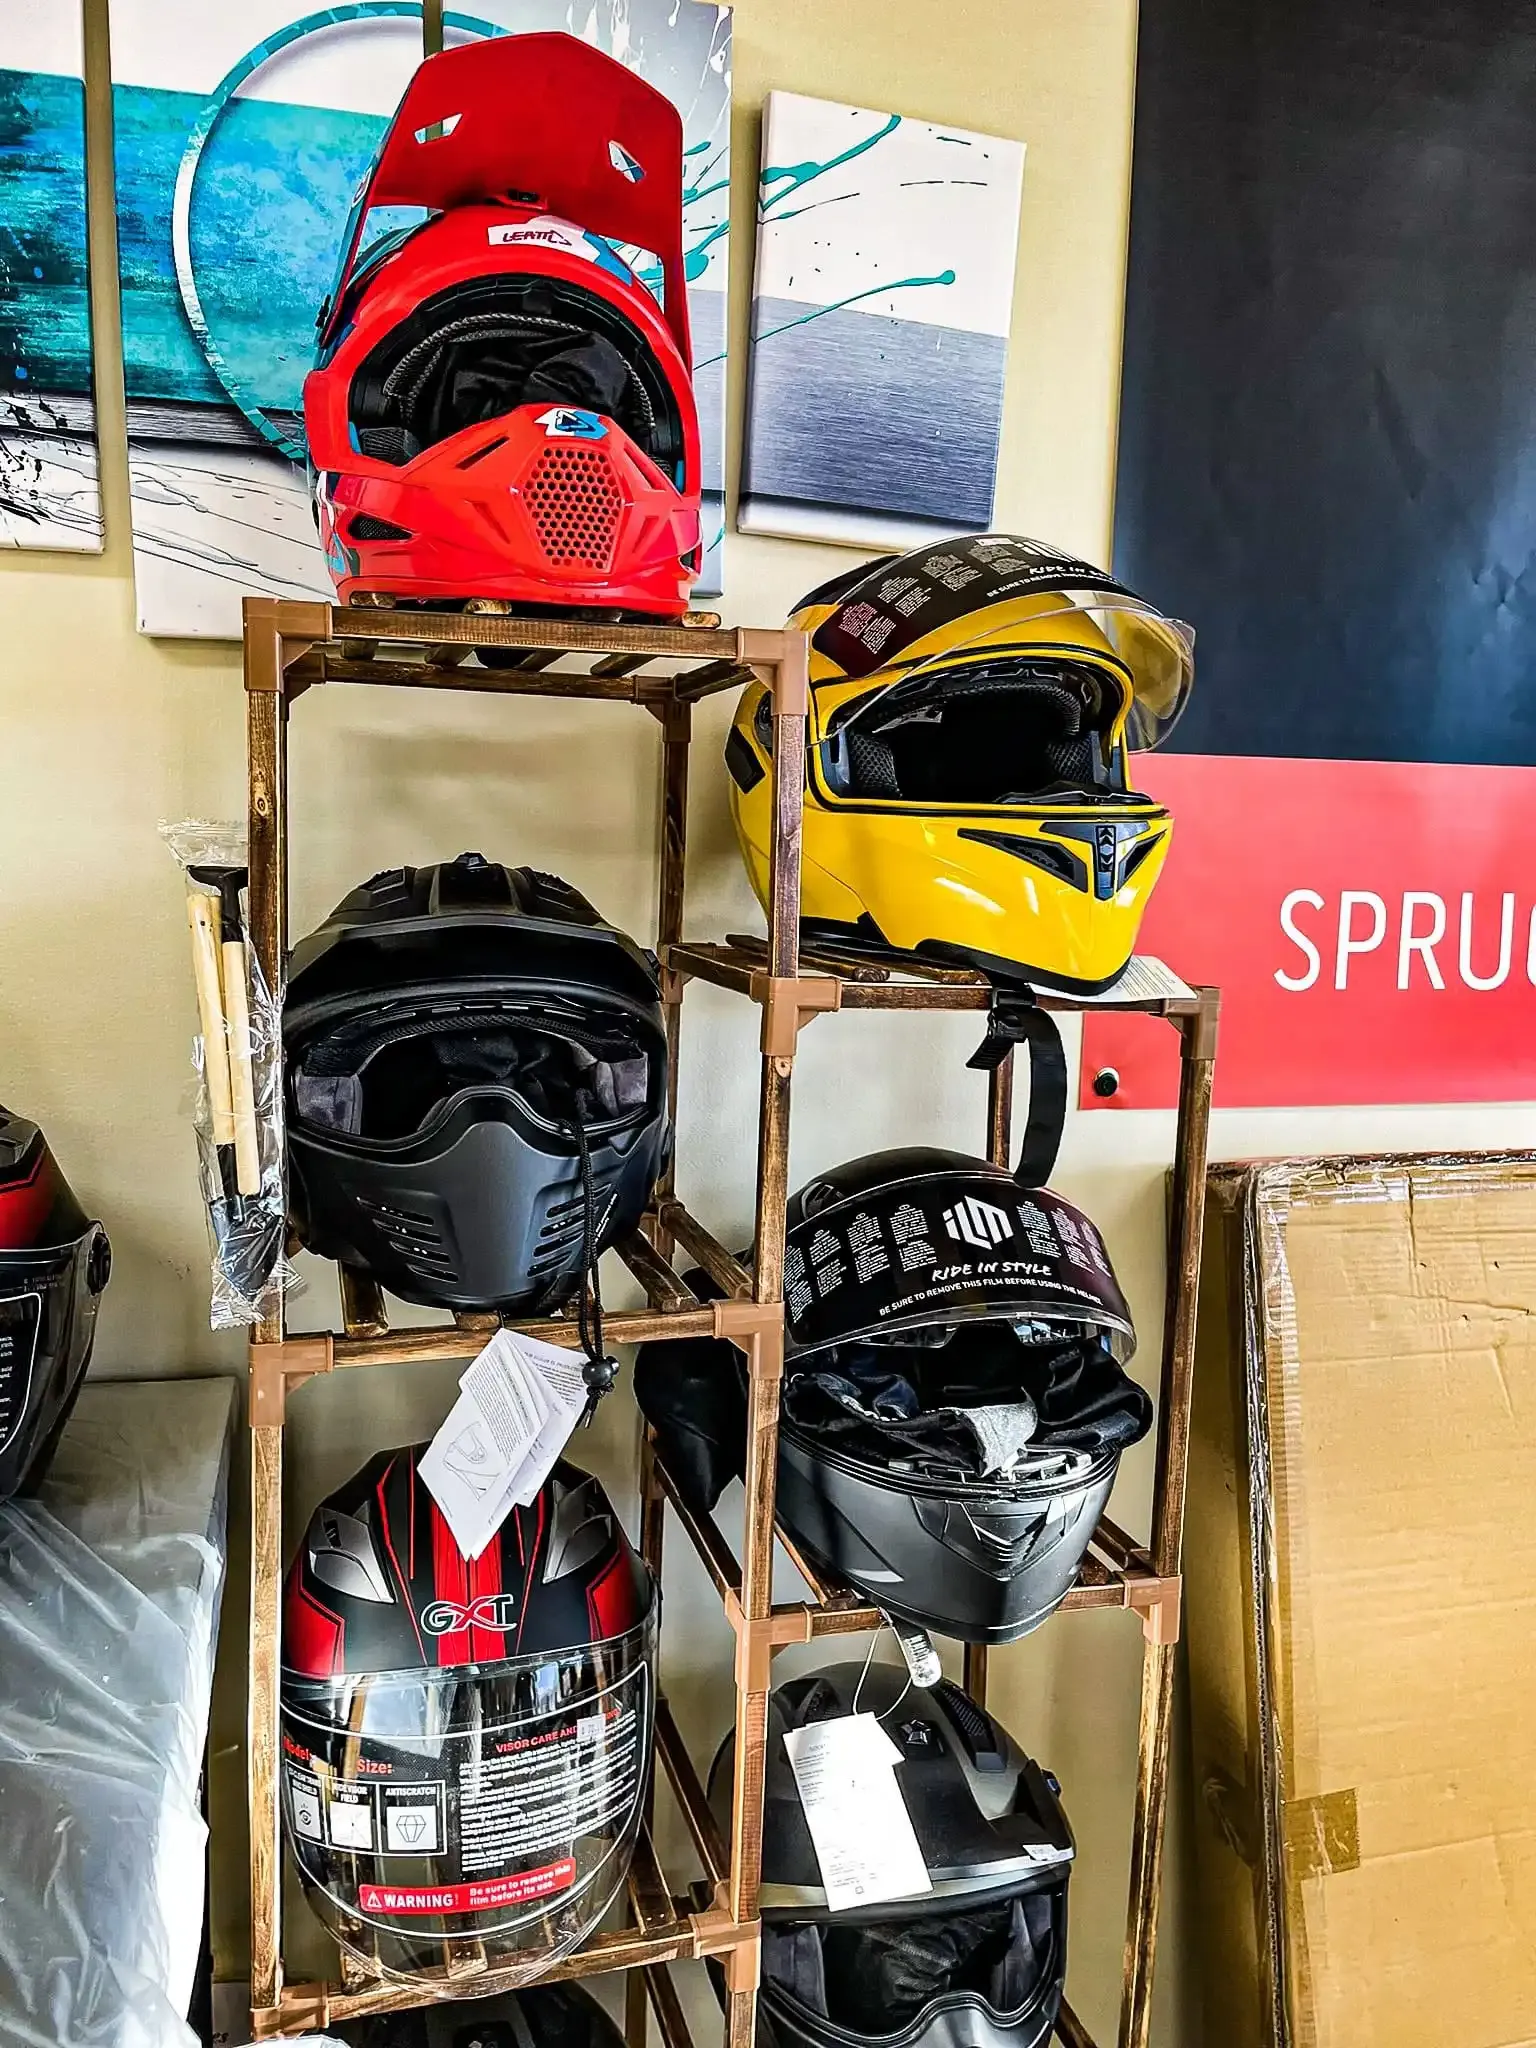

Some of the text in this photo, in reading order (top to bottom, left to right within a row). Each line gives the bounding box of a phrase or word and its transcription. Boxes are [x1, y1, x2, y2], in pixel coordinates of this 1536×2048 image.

[1273, 888, 1536, 992] SPRU
[931, 1262, 1052, 1281] RIDE IN STYLE
[879, 1305, 891, 1316] BE
[891, 1296, 914, 1311] SURE
[914, 1292, 926, 1300] TO
[926, 1282, 962, 1297] REMOVE
[962, 1280, 982, 1289] THIS
[982, 1278, 1004, 1286] FILM
[1004, 1278, 1038, 1286] BEFORE
[495, 1739, 530, 1753] VISOR
[530, 1731, 559, 1746] CARE
[356, 1758, 393, 1774] Size:
[469, 1888, 483, 1897] Be
[485, 1883, 507, 1894] sure
[508, 1881, 519, 1890] to
[520, 1872, 554, 1887] remove
[490, 1889, 522, 1902] before
